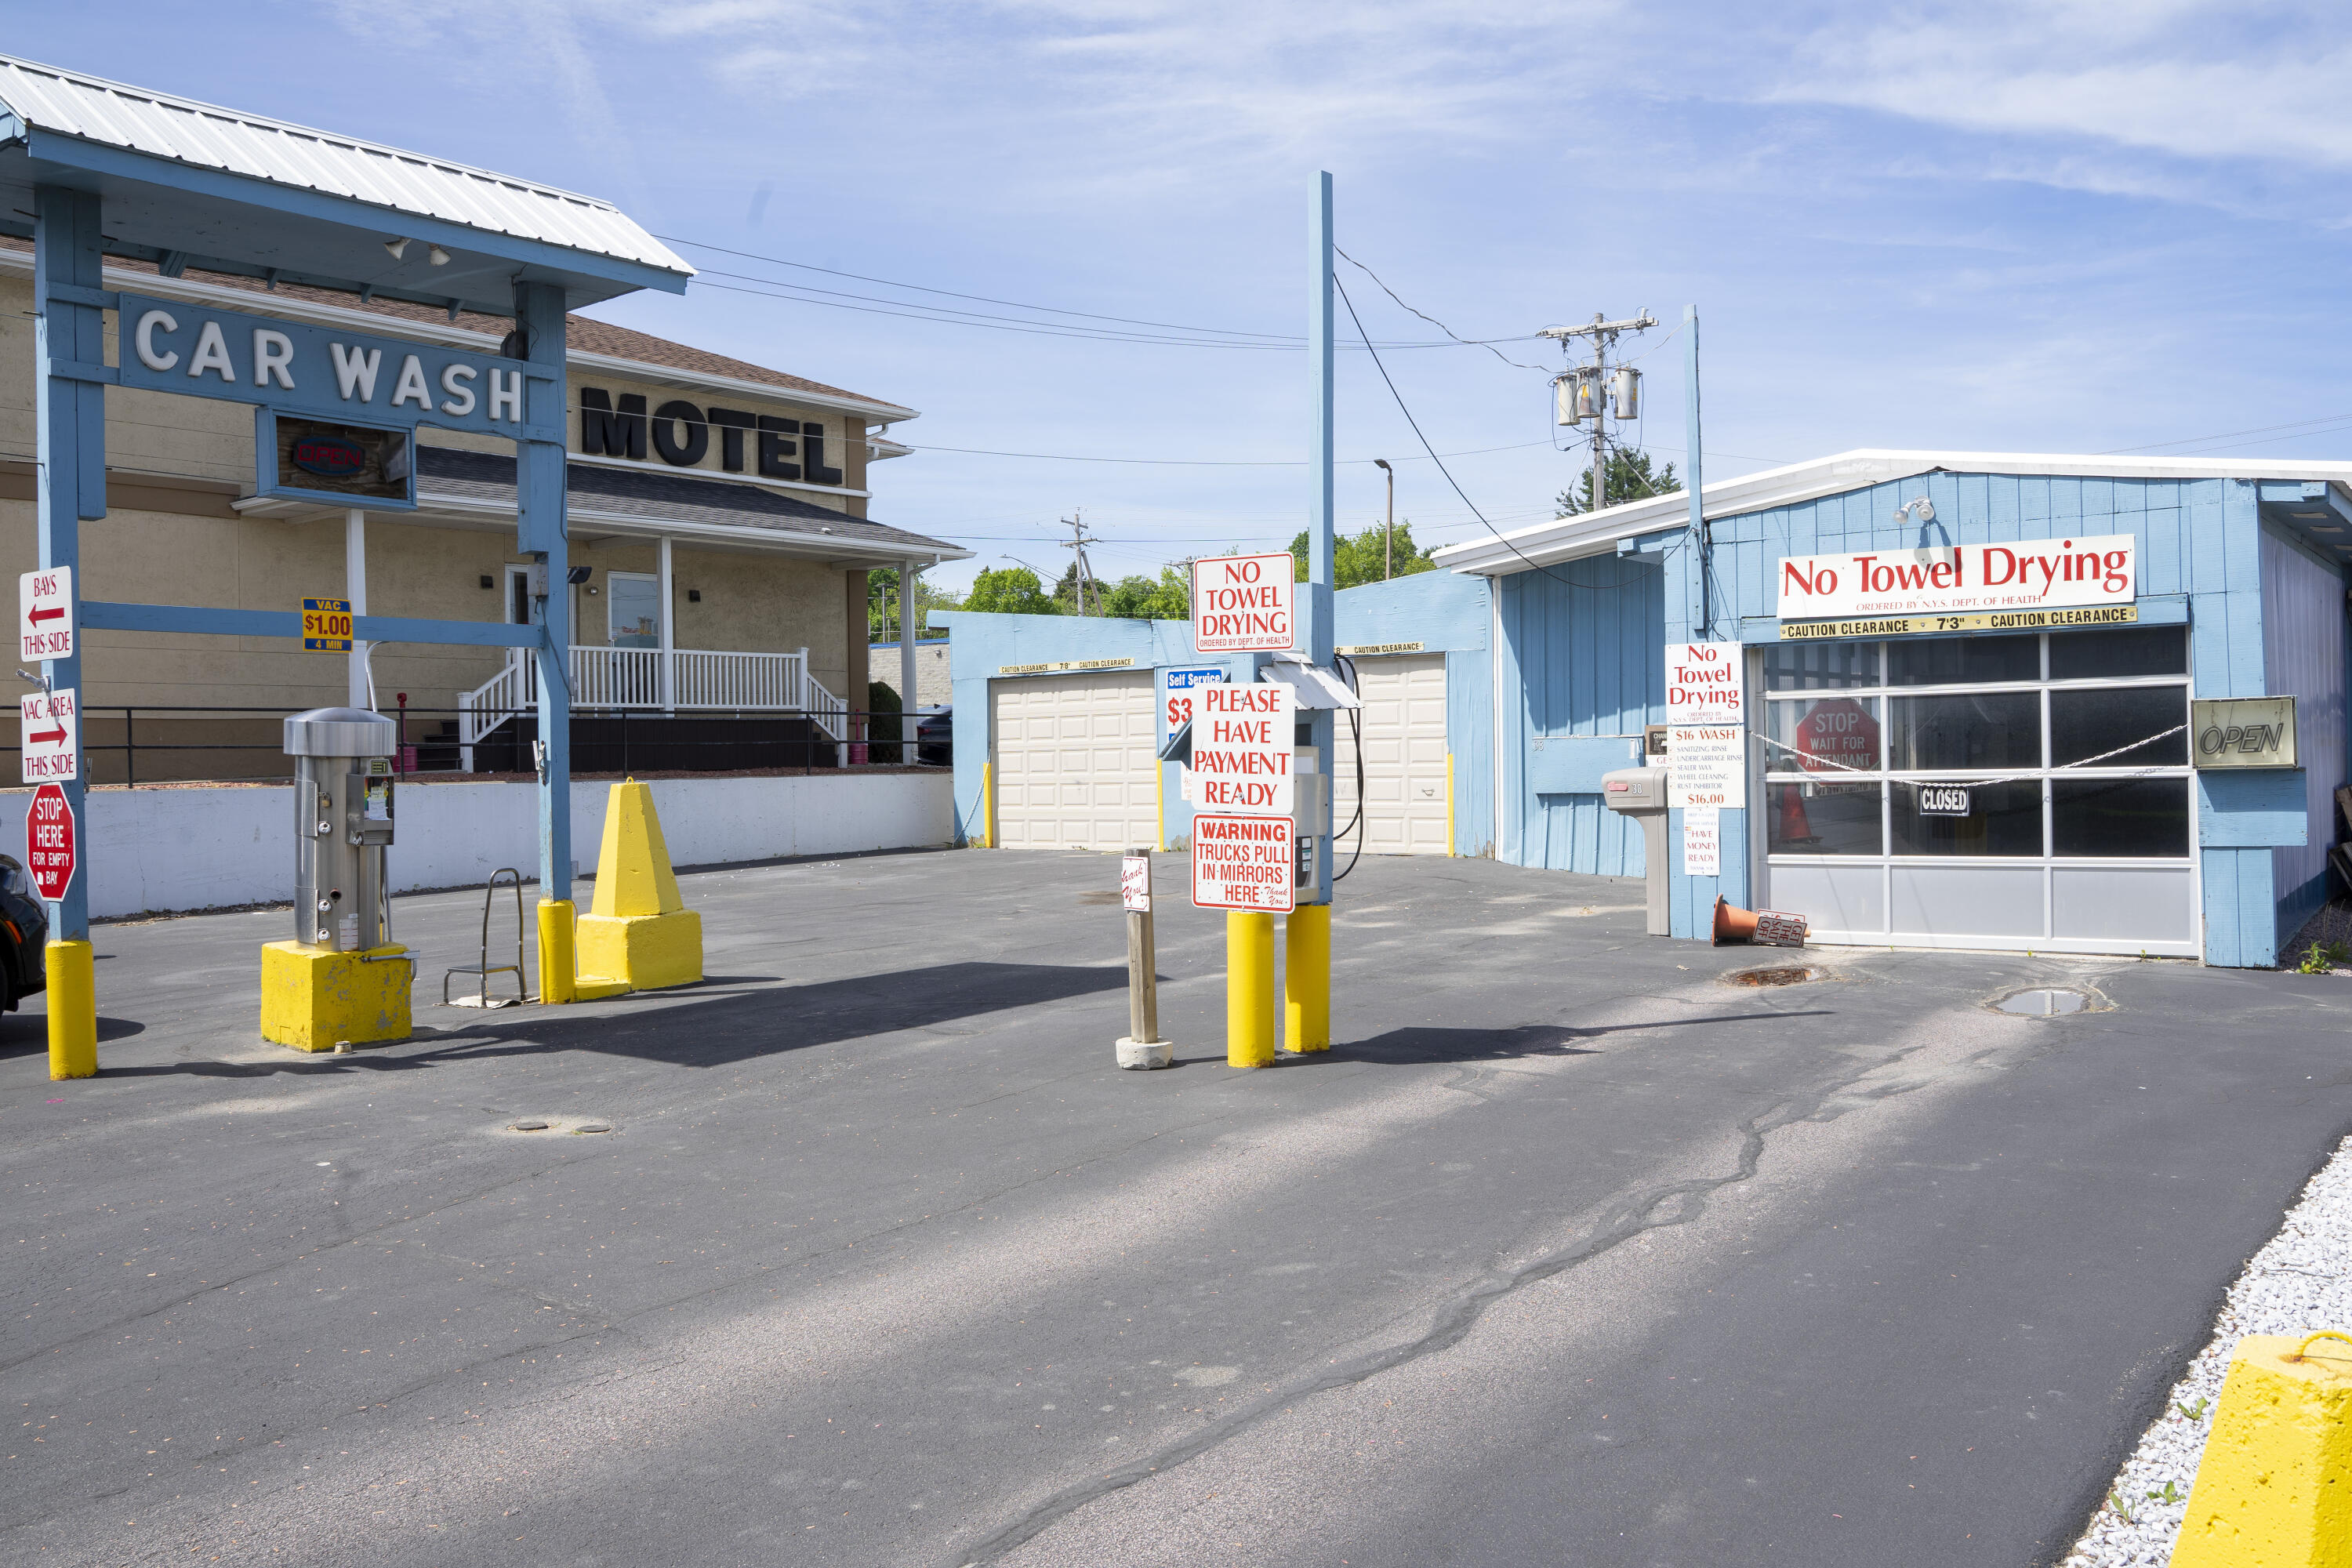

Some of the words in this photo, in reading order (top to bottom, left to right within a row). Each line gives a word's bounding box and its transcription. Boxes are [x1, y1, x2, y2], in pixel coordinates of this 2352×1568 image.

[136, 310, 296, 390] CAR
[329, 342, 521, 423] WASH
[581, 387, 842, 485] MOTEL
[297, 445, 362, 466] OPEN
[1225, 561, 1261, 584] NO
[1784, 560, 1838, 597] No
[1853, 546, 1962, 593] Towel
[1982, 539, 2129, 597] Drying
[34, 575, 56, 597] BAYS
[316, 601, 341, 611] VAC
[1206, 586, 1282, 611] TOWEL
[1856, 601, 1903, 612] ORDERED
[1907, 601, 1918, 609] BY
[1922, 600, 1948, 608] N.Y.S.
[1952, 598, 1980, 607] DEPT.
[1984, 597, 1998, 605] OF
[2002, 595, 2042, 604] HEALTH
[305, 614, 350, 636] $1.00
[1203, 612, 1287, 636] DRYING
[1788, 624, 1836, 637] CAUTION
[1841, 620, 1909, 635] CLEARANCE
[1936, 617, 1965, 630] 7'3"
[1991, 612, 2045, 627] CAUTION
[2051, 608, 2127, 624] CLEARANCE
[24, 634, 45, 655] THIS
[49, 631, 70, 652] SIDE
[315, 639, 321, 649] 4
[326, 640, 343, 650] MIN
[1200, 638, 1227, 647] ORDERED
[1266, 636, 1290, 644] HEALTH
[1354, 645, 1380, 654] CAUTION
[1381, 643, 1420, 653] CLEARANCE
[1689, 644, 1717, 662] No
[1021, 663, 1048, 672] CLEARANCE
[1079, 660, 1099, 669] CAUTION
[1101, 659, 1131, 667] CLEARANCE
[1674, 662, 1731, 684] Towel
[1169, 673, 1185, 687] Self
[1188, 672, 1221, 686] Service
[24, 699, 42, 720] VAC
[46, 695, 74, 717] AREA
[1207, 690, 1280, 713] PLEASE
[1670, 684, 1740, 710] Drying
[1214, 720, 1271, 743] HAVE
[1816, 713, 1859, 733] STOP
[1675, 730, 1694, 741] $16
[1699, 729, 1735, 740] WASH
[1810, 737, 1837, 750] WAIT
[1843, 736, 1865, 750] FOR
[2200, 723, 2284, 755] OPEN
[25, 756, 48, 776] THIS
[52, 753, 74, 775] SIDE
[1194, 750, 1290, 775] PAYMENT
[1806, 753, 1871, 768] ATTENDANT
[1205, 781, 1278, 806] READY
[1688, 793, 1724, 804] $16.00
[1922, 789, 1967, 811] CLOSED
[37, 797, 64, 820] STOP
[37, 825, 64, 848] HERE
[1201, 822, 1286, 842] WARNING
[33, 852, 45, 866] FOR
[49, 852, 70, 866] EMPTY
[1198, 843, 1250, 862] TRUCKS
[1254, 845, 1289, 864] PULL
[46, 871, 58, 884] BAY
[1121, 862, 1143, 883] hank
[1203, 863, 1215, 880] IN
[1220, 864, 1283, 884] MIRRORS
[1225, 884, 1259, 903] HERE
[1264, 886, 1288, 897] Thank
[1269, 896, 1284, 906] You
[1758, 920, 1771, 938] OFF
[1768, 920, 1782, 942] SALT
[1778, 924, 1791, 942] THE
[1789, 924, 1802, 943] GET
